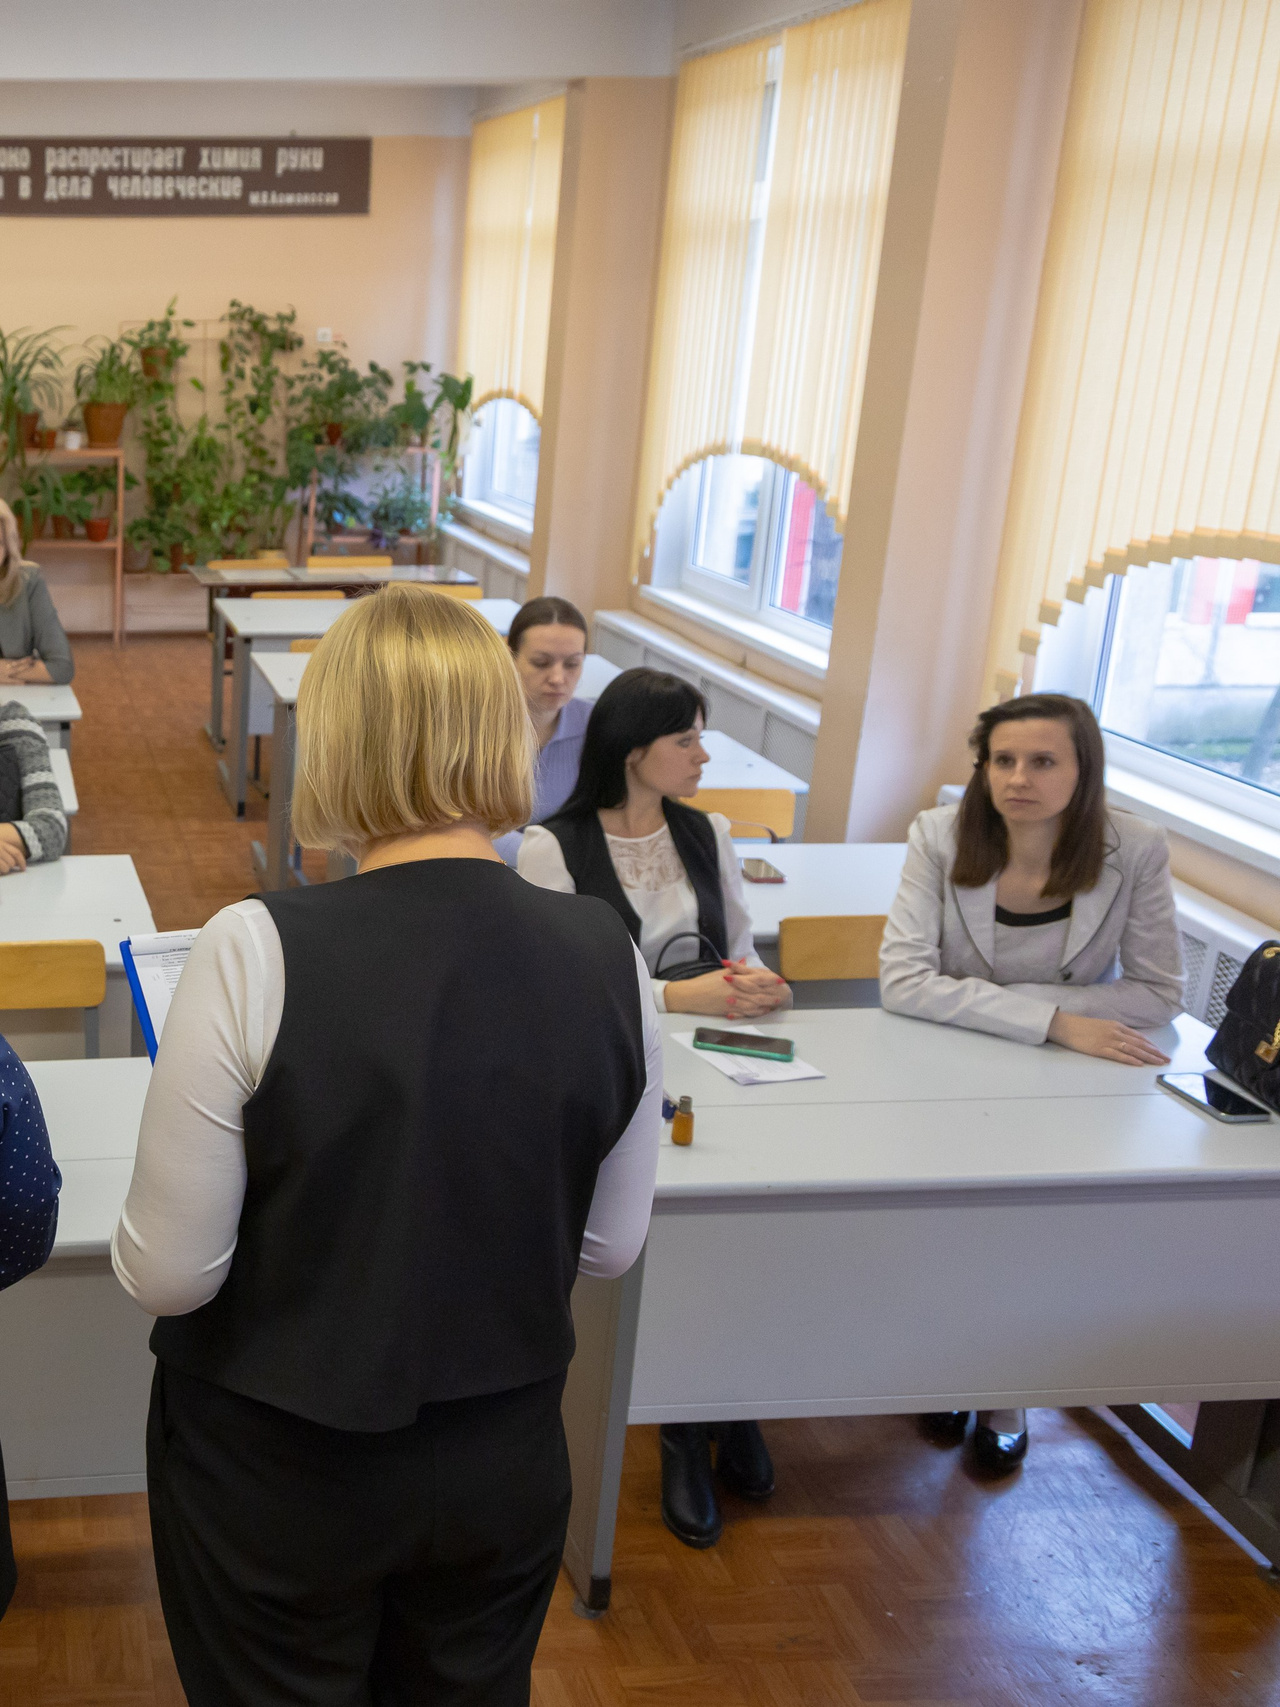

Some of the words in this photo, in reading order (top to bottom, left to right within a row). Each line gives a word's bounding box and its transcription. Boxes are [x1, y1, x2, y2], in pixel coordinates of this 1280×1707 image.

[199, 146, 262, 171] химия
[44, 175, 93, 201] дела
[107, 175, 243, 200] человеческие
